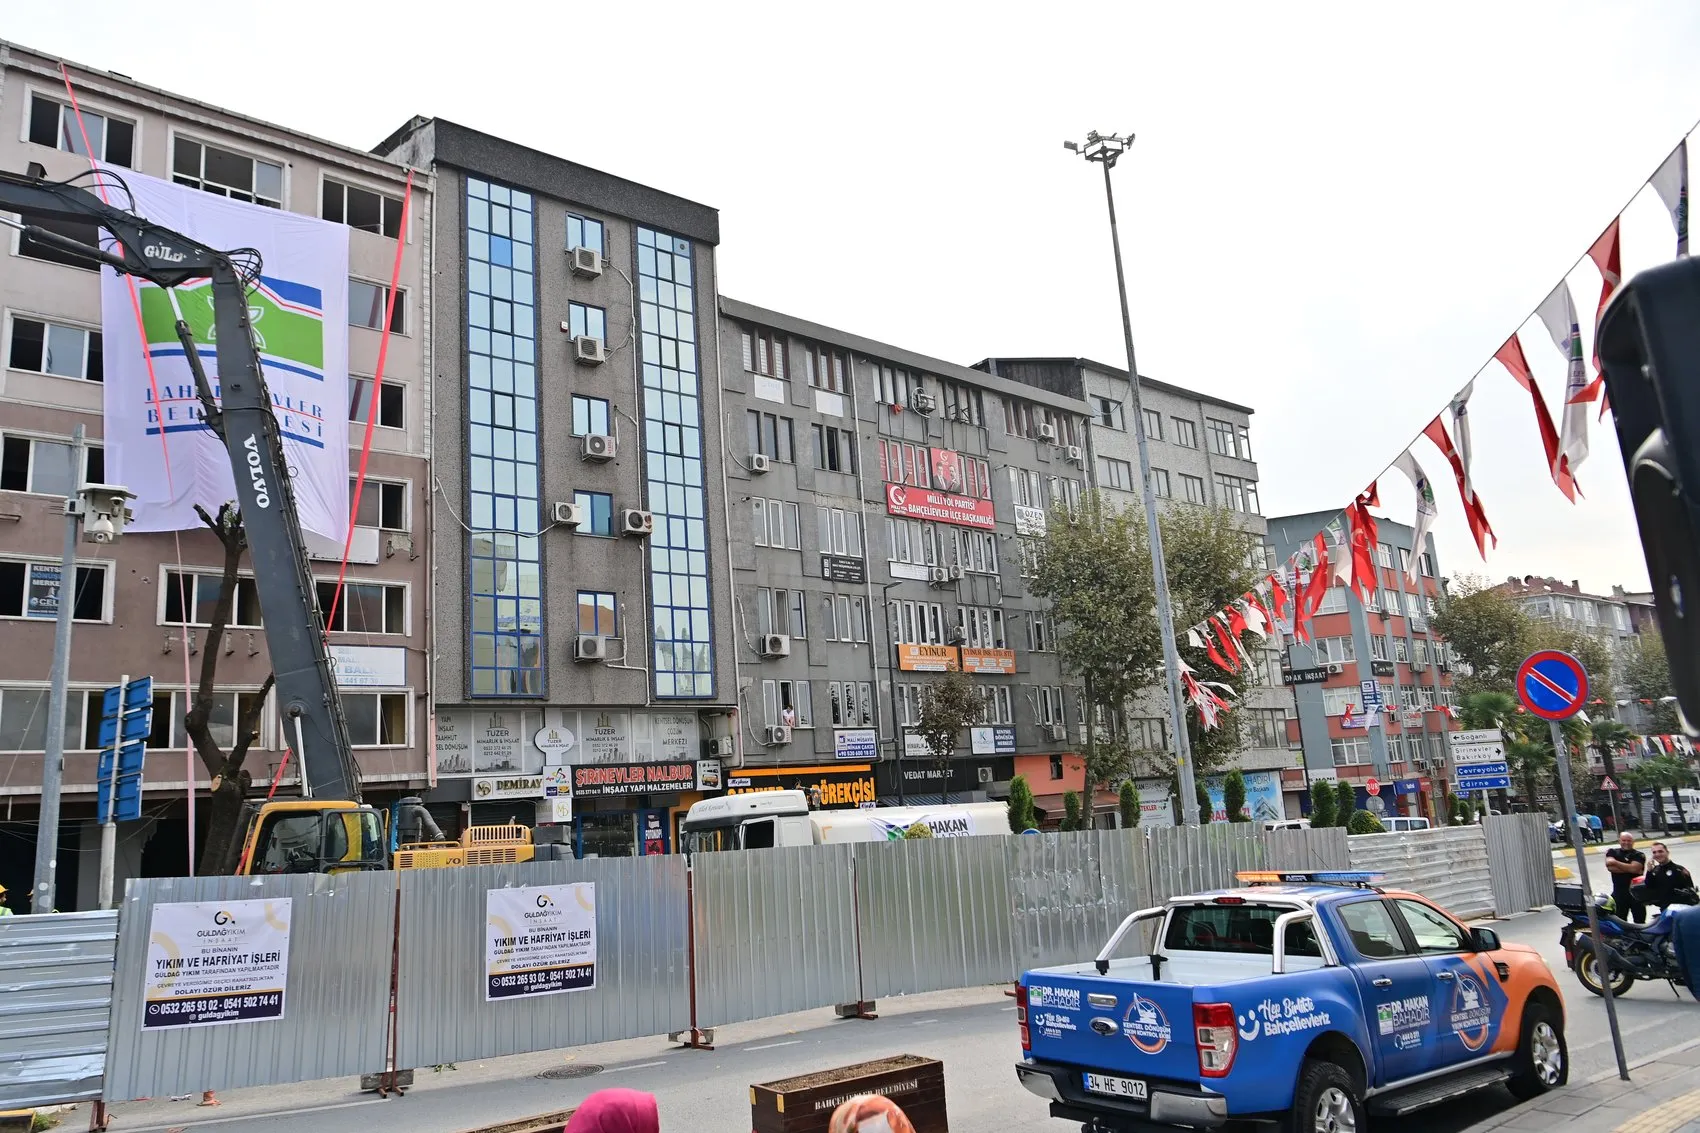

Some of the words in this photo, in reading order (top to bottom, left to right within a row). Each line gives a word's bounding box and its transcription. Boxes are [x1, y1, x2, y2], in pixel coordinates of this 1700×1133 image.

[244, 434, 270, 508] VOLVO
[926, 493, 942, 503] MİLLİ
[944, 496, 954, 506] YOL
[955, 498, 976, 510] PARTİSİ
[908, 504, 949, 518] BAHÇELİEVLER
[950, 509, 961, 522] İLÇE
[962, 512, 994, 525] BAŞKANLIĞI
[576, 768, 644, 787] ŞİRİNEVLER
[647, 765, 693, 782] NALBUR
[904, 770, 925, 780] VEDAT
[1458, 766, 1498, 775] Çevreyolu
[496, 778, 542, 791] DEMİRAY
[602, 785, 628, 794] İNŞAAT
[630, 784, 646, 793] YAPI
[647, 781, 693, 791] MALZEMELERİ
[928, 819, 968, 834] HAKAN
[494, 937, 516, 947] YIKIM
[519, 936, 528, 945] VE
[531, 932, 565, 944] HAFRİYAT
[568, 928, 591, 940] İŞLERİ
[156, 958, 184, 969] YIKIM
[187, 957, 199, 967] VE
[202, 952, 248, 966] HAFRİYAT
[251, 950, 280, 965] İŞLERİ
[238, 965, 279, 973] YAPILMAKTADIR
[502, 976, 516, 987] 0532
[517, 975, 528, 985] 265
[529, 974, 537, 984] 93
[538, 973, 545, 982] 02
[550, 971, 563, 981] 0541
[565, 969, 576, 979] 502
[577, 968, 584, 977] 74
[585, 967, 592, 977] 41
[203, 986, 222, 994] ÖZÜR
[531, 981, 562, 991] guldagyikim
[1043, 986, 1053, 996] DR.
[1055, 987, 1080, 999] HAKAN
[161, 1002, 180, 1014] 0532
[181, 1001, 195, 1012] 265
[197, 1000, 206, 1011] 93
[208, 1000, 218, 1010] 02
[224, 998, 241, 1009] 0541
[243, 997, 257, 1007] 502
[259, 996, 268, 1006] 74
[269, 995, 278, 1005] 41
[1043, 995, 1080, 1007] BAHADIR
[1258, 999, 1282, 1022] Hep
[1283, 997, 1315, 1018] Birlikte
[1391, 1001, 1404, 1014] DR.
[1404, 996, 1429, 1012] HAKAN
[198, 1010, 239, 1020] guldagyikim
[1393, 1008, 1430, 1026] BAHADIR
[1264, 1012, 1331, 1036] Bahçelievleriz
[875, 1079, 918, 1096] BELEDİYESİ
[1089, 1076, 1100, 1089] 34
[1104, 1079, 1116, 1092] HE
[1122, 1080, 1144, 1096] 9012
